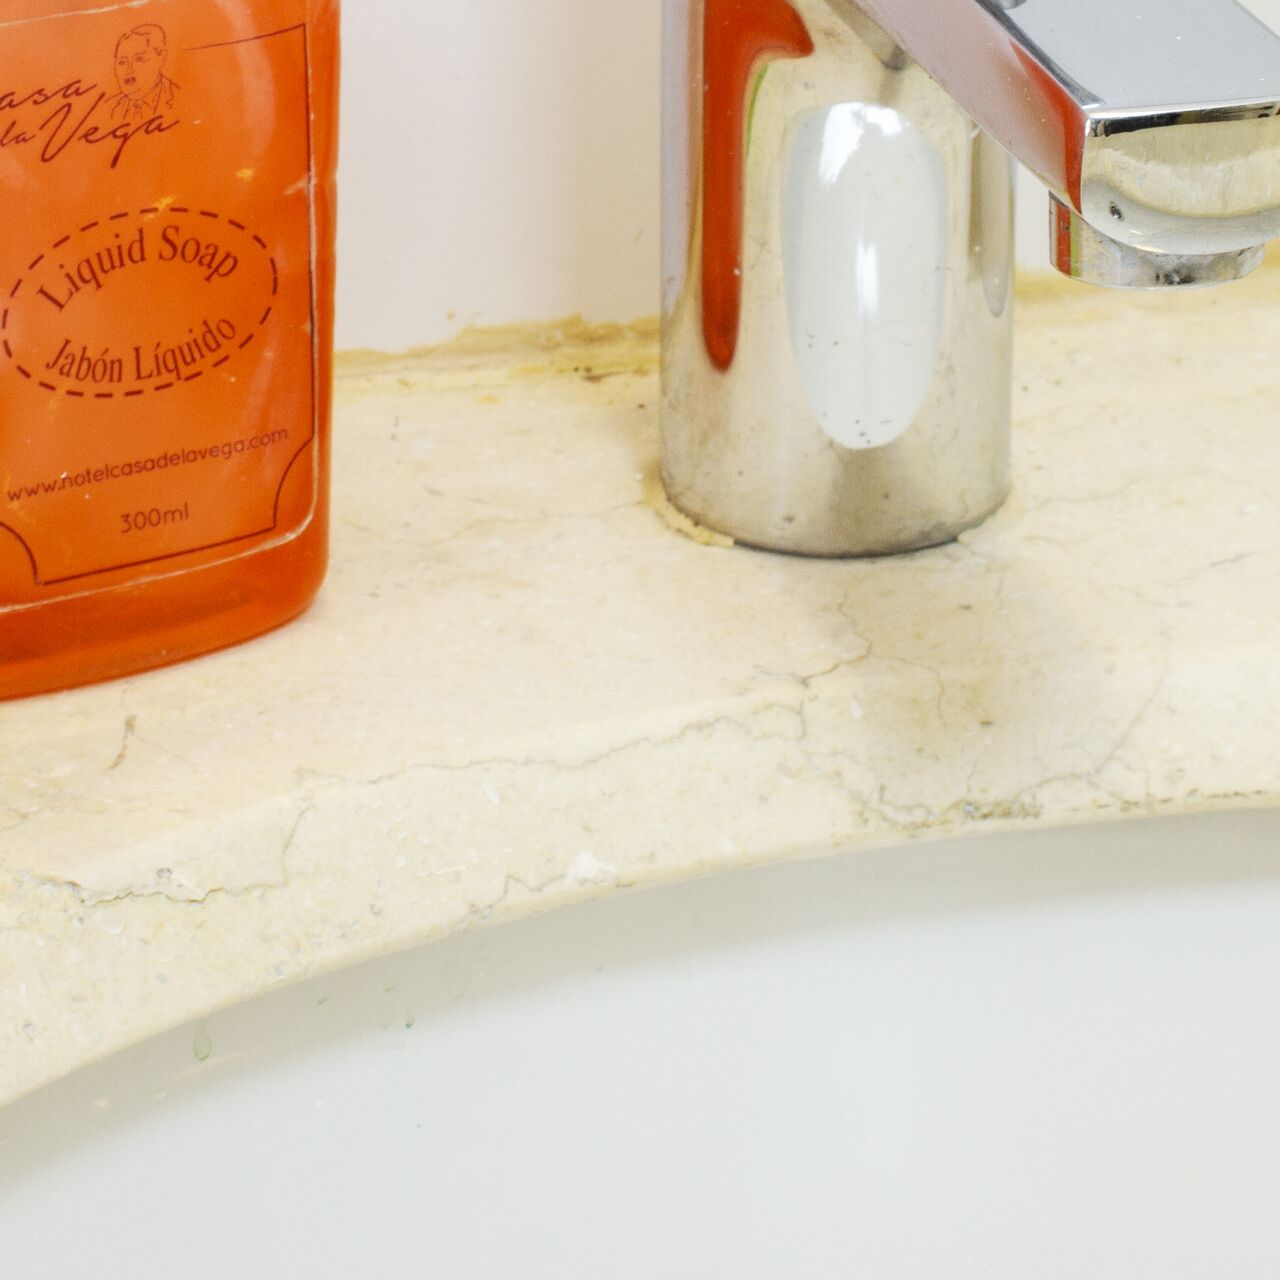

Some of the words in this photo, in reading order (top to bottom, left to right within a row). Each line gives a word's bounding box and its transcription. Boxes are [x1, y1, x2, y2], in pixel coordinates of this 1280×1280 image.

[29, 92, 180, 169] Vega
[36, 228, 147, 313] Liquid
[158, 225, 239, 283] Soap
[45, 338, 123, 384] Jabón
[133, 318, 236, 382] Líquido
[120, 502, 189, 534] 300ml
